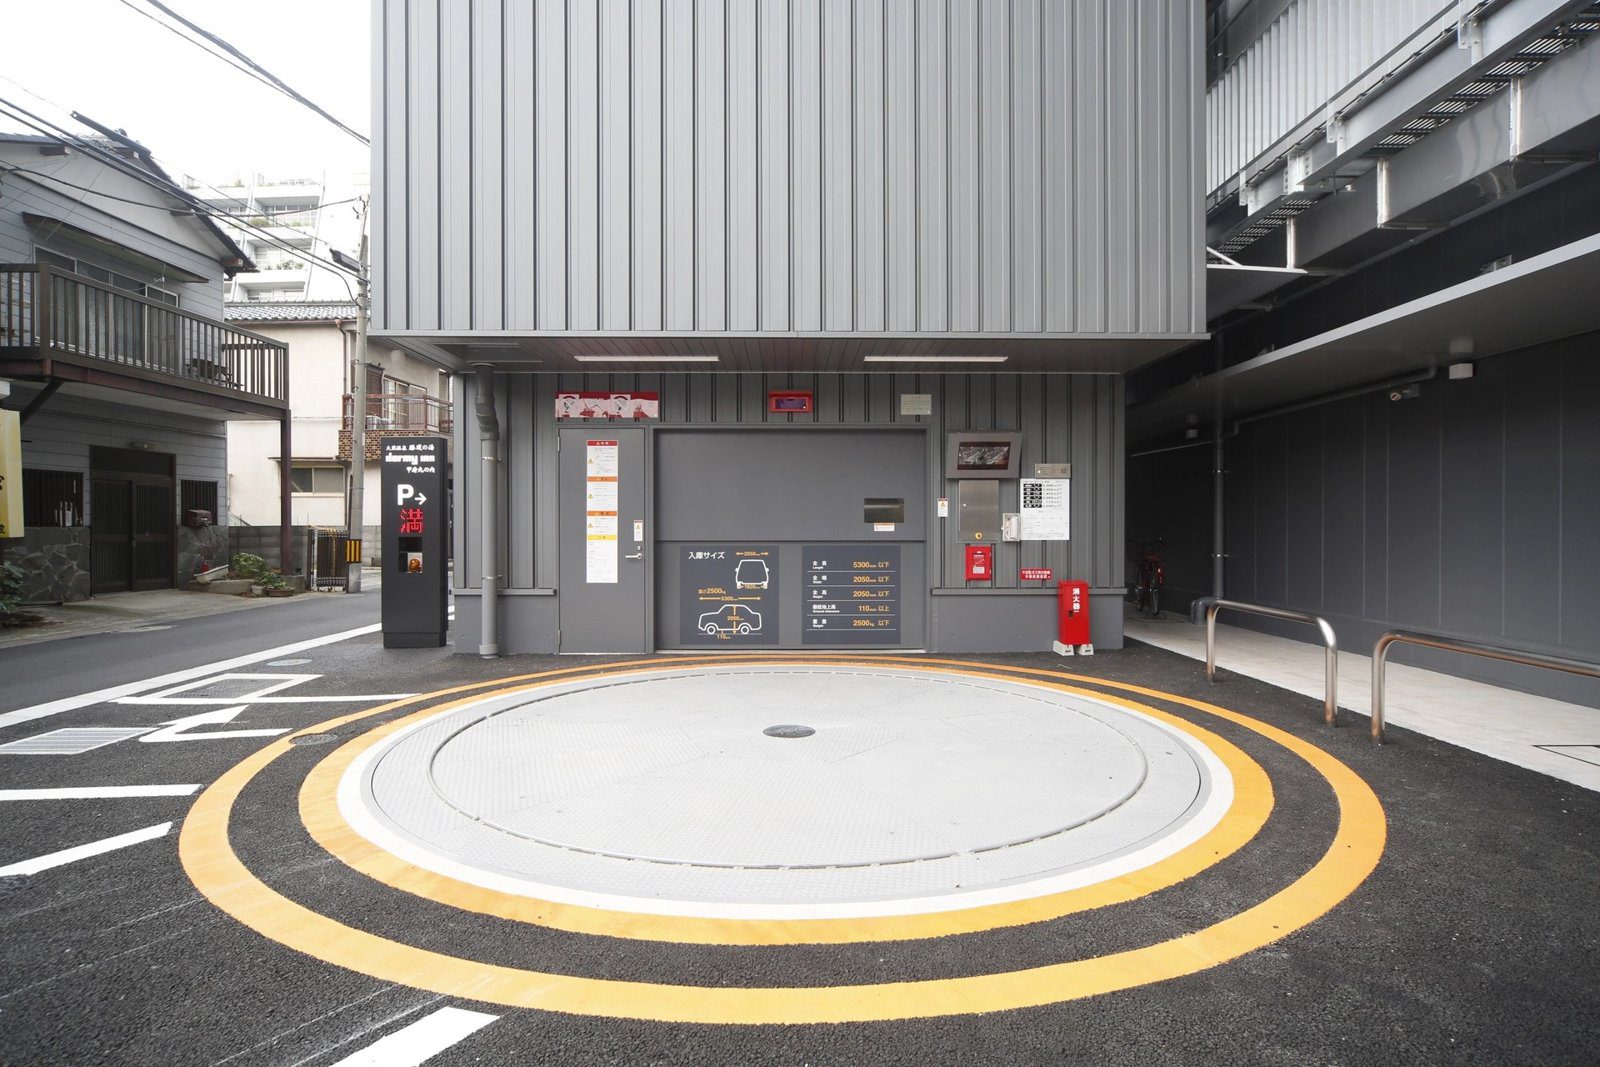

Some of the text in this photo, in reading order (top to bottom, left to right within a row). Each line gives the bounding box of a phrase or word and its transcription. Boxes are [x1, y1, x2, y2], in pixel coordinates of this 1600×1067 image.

[385, 452, 418, 465] dormy
[397, 484, 414, 506] P
[400, 508, 423, 534] 満
[688, 551, 725, 560] 入庫サイズ
